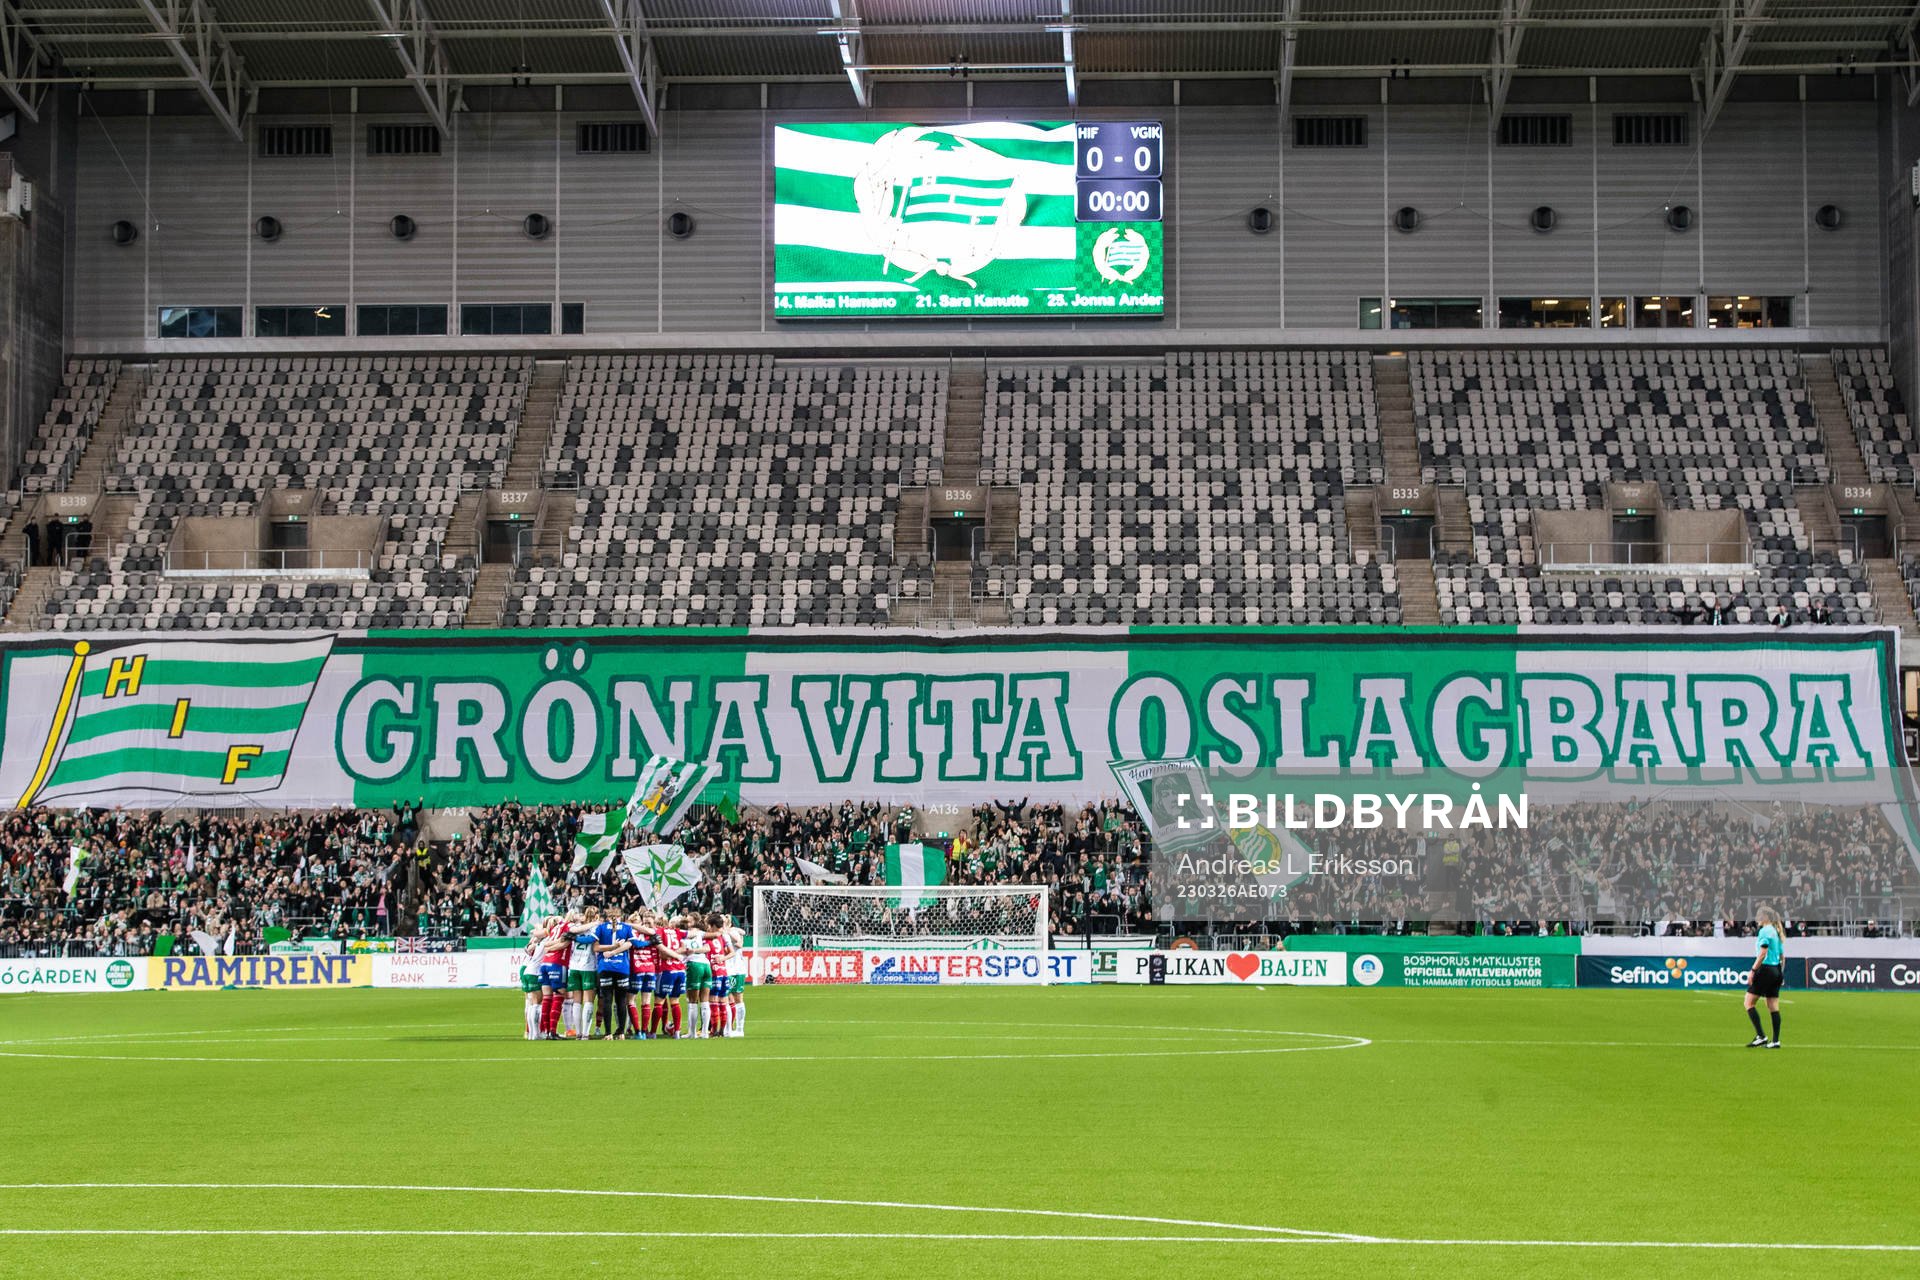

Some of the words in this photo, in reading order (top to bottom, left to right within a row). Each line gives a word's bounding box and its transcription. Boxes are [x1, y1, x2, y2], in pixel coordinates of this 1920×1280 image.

[1077, 126, 1100, 140] HIF
[1130, 126, 1161, 139] VGIK
[1086, 146, 1103, 172] 0
[1134, 146, 1152, 172] 0
[1088, 190, 1150, 212] 00:00
[838, 295, 897, 309] Hamano
[915, 294, 938, 308] 21.
[939, 294, 971, 308] Sara
[1071, 293, 1116, 307] Jonna
[1119, 293, 1164, 306] Ander
[501, 492, 528, 503] B337
[945, 490, 973, 501] B336
[1392, 488, 1419, 499] B335
[1844, 487, 1872, 498] B334
[60, 496, 87, 507] B338
[1107, 669, 1877, 789] OSLAGBARA
[929, 803, 959, 815] A136
[391, 955, 458, 966] MARGINAL
[901, 955, 1078, 978] INTERSPORT
[1136, 957, 1225, 976] PLIKAN
[1260, 959, 1328, 977] BAJEN
[1403, 956, 1470, 967] BOSPHORUS
[1473, 956, 1542, 967] MATKLUSTER
[163, 955, 357, 987] RAMIRENT
[391, 972, 425, 983] BANK
[1403, 967, 1454, 977] OFFICIELL
[1455, 966, 1542, 977] MATLEVERANTÖR
[1611, 965, 1669, 985] Sefina
[1811, 963, 1875, 985] Convini
[1404, 978, 1421, 986] TILL
[1423, 978, 1468, 986] HAMMARBY
[1471, 978, 1512, 987] FOTBOLLS
[1513, 978, 1542, 987] DAMER
